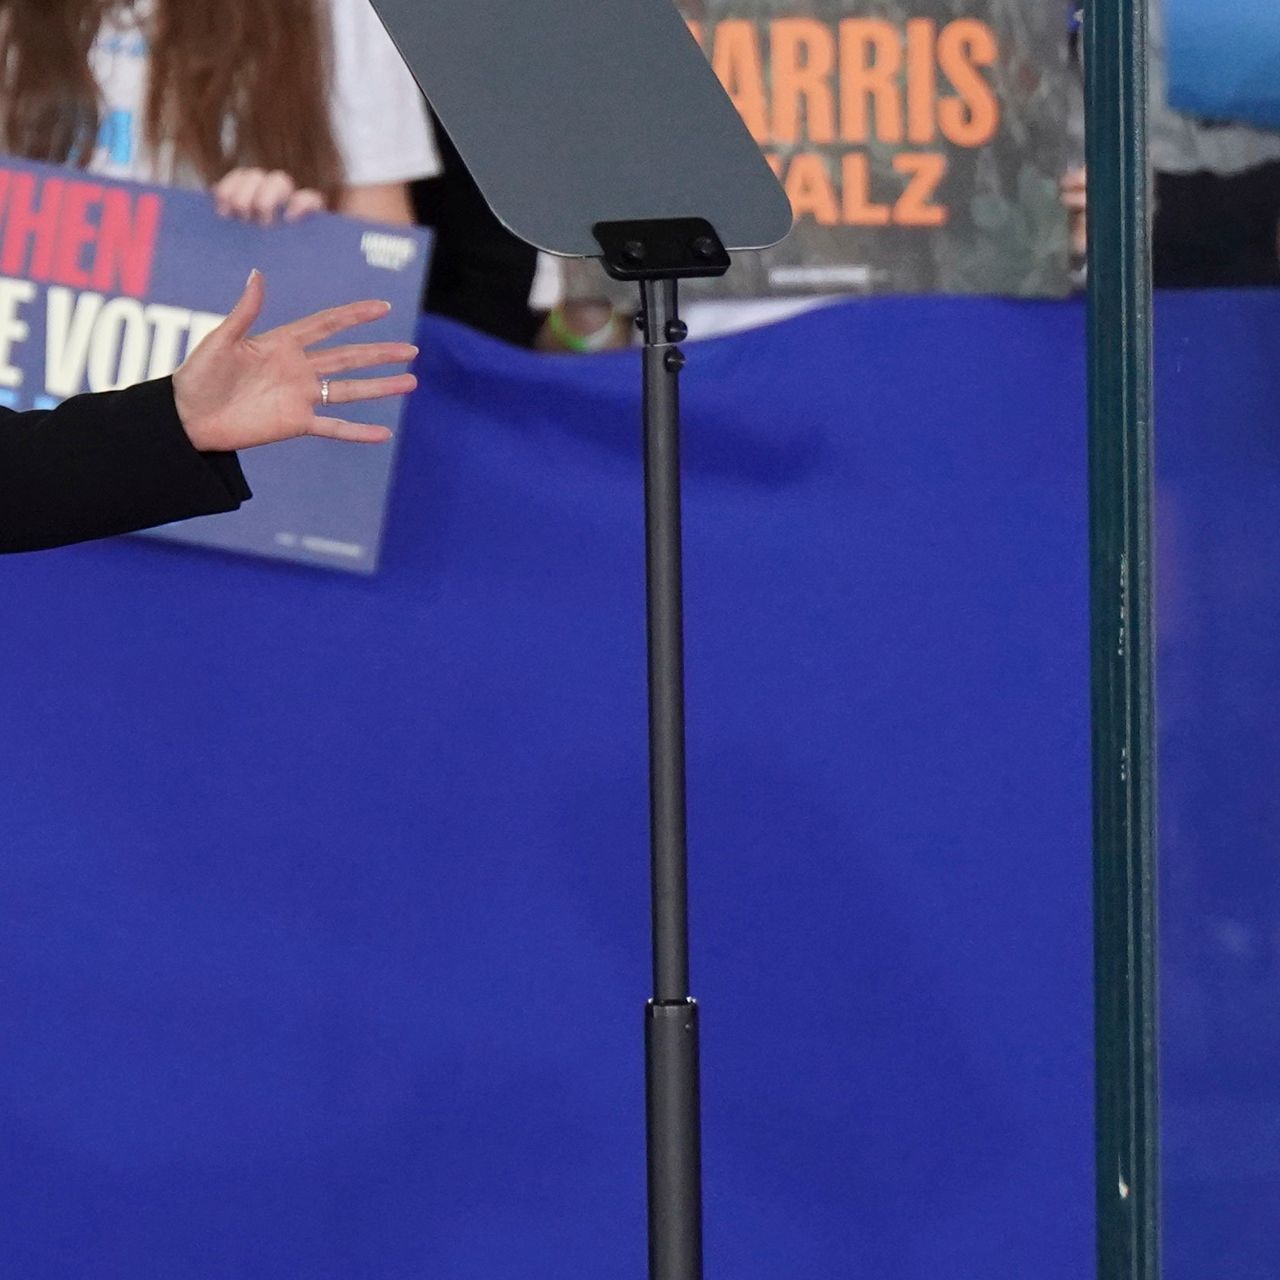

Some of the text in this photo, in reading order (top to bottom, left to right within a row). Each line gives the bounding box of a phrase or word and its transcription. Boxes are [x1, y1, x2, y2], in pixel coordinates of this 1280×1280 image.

[684, 16, 1002, 150] ARRIS
[762, 151, 950, 227] ALZ
[43, 285, 228, 400] VOT
